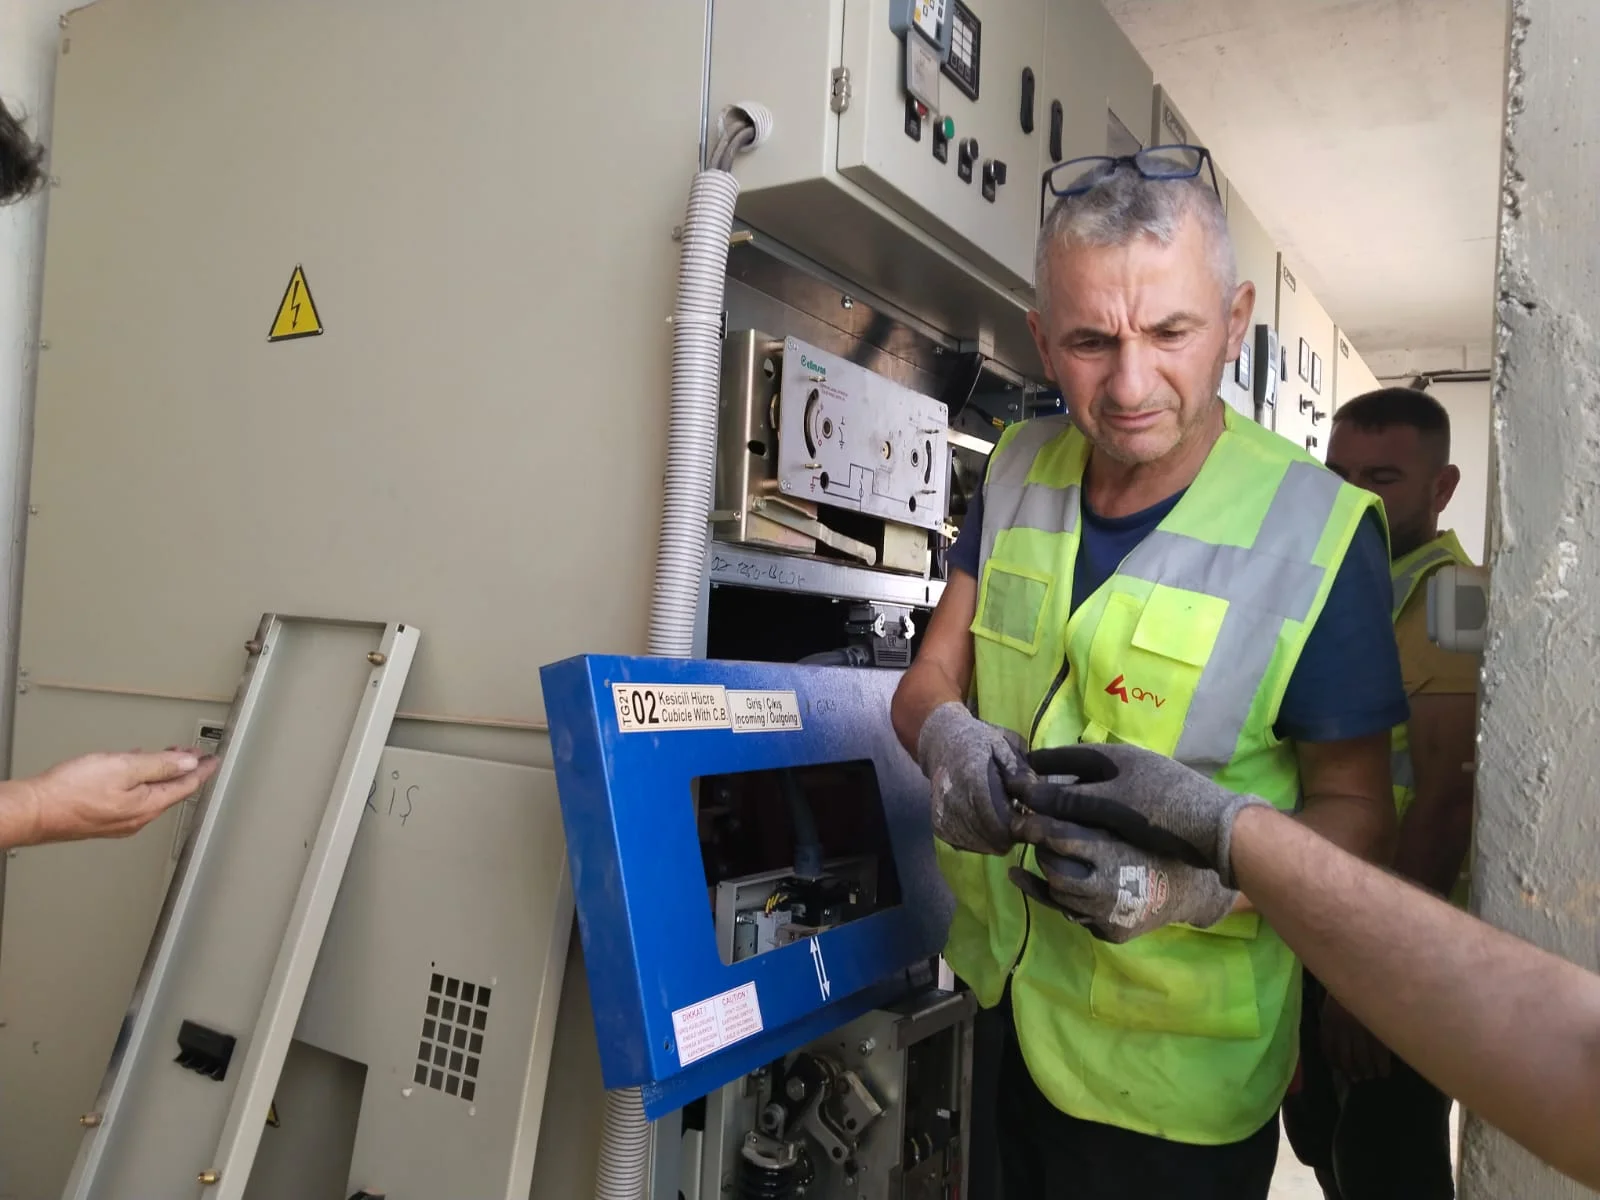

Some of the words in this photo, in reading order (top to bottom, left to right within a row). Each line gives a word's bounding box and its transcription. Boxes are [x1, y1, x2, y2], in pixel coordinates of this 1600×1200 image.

[658, 691, 690, 705] Kesicili
[691, 691, 715, 705] Hücre
[745, 697, 763, 711] Giriş
[632, 690, 660, 724] 02
[661, 708, 693, 723] Cubicle
[693, 708, 711, 721] With
[712, 707, 729, 721] C.B.
[734, 712, 766, 727] Incoming
[769, 711, 798, 726] Outgoing
